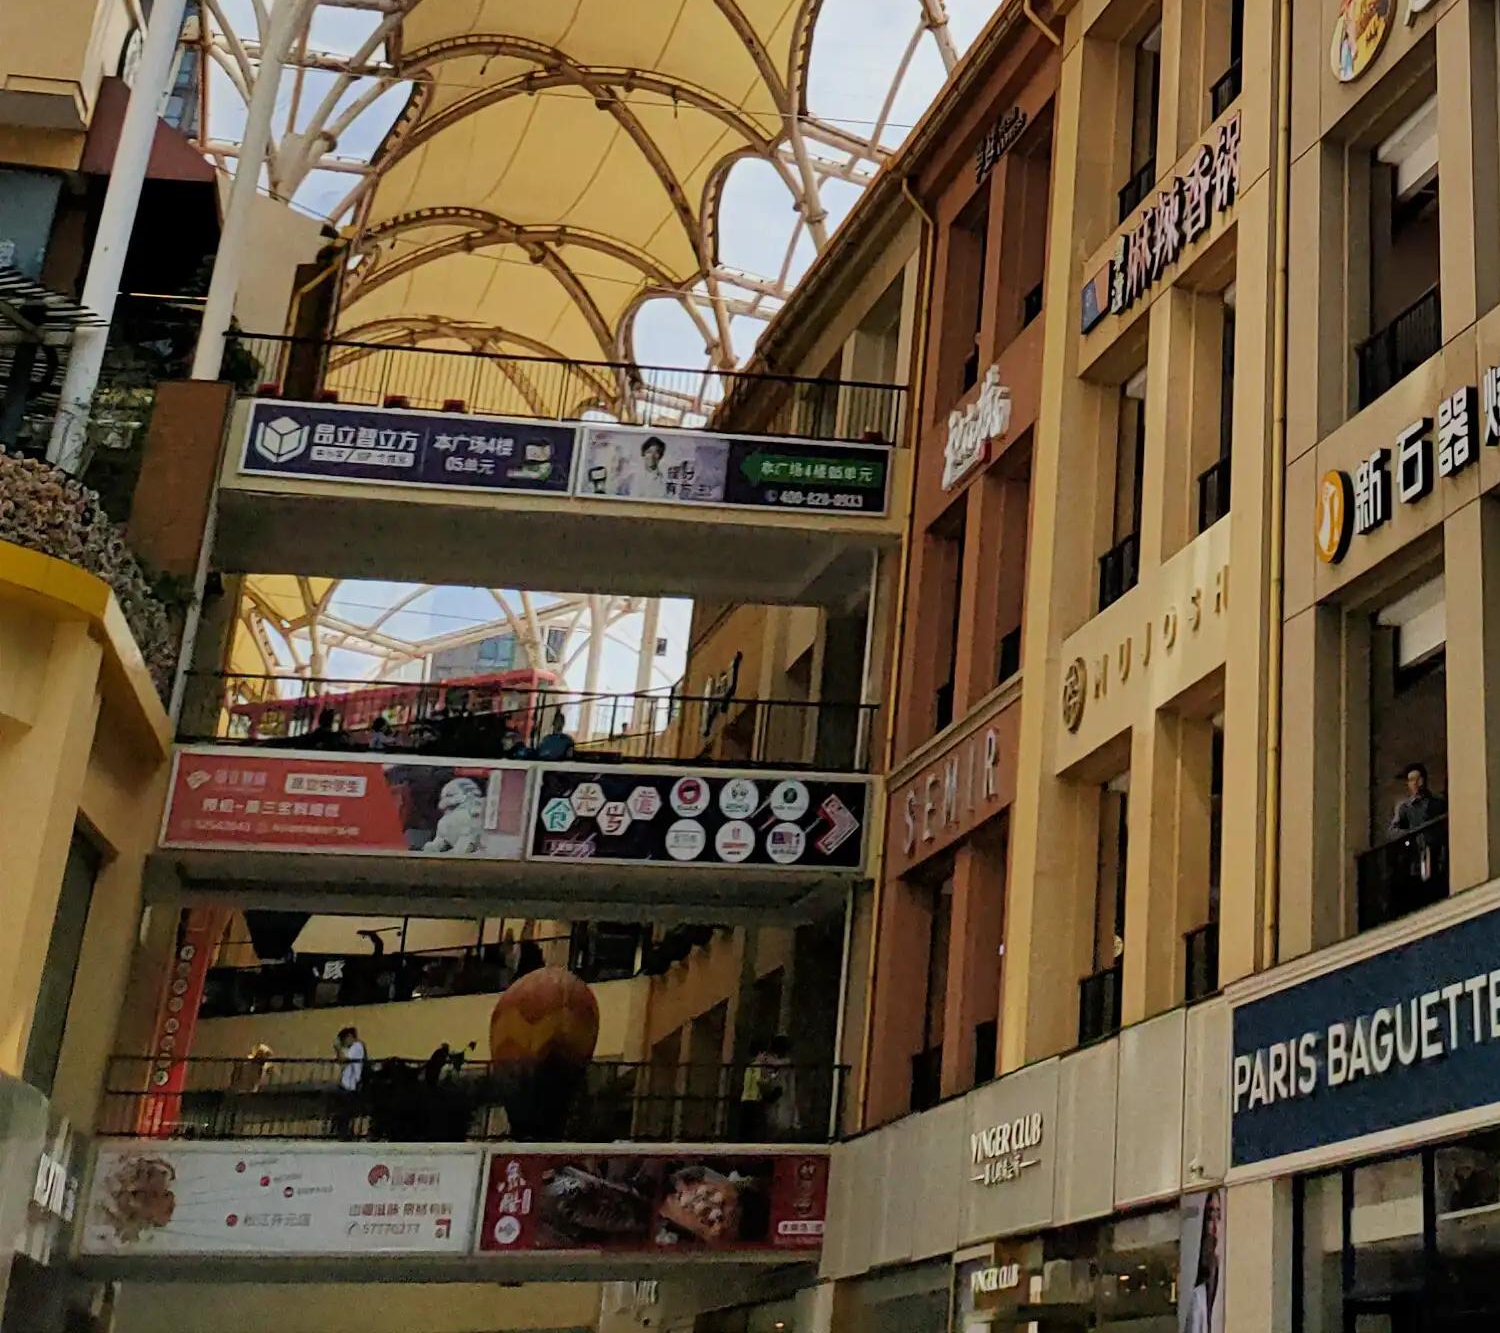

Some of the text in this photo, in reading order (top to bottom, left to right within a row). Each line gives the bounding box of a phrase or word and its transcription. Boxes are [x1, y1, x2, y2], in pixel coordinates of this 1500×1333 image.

[1126, 110, 1241, 299] 麻辣香锅
[313, 424, 420, 452] 昂立智立方
[903, 729, 998, 855] SEMIR
[1233, 1031, 1319, 1114] PARIS
[970, 1112, 1042, 1164] YINGER CLUB
